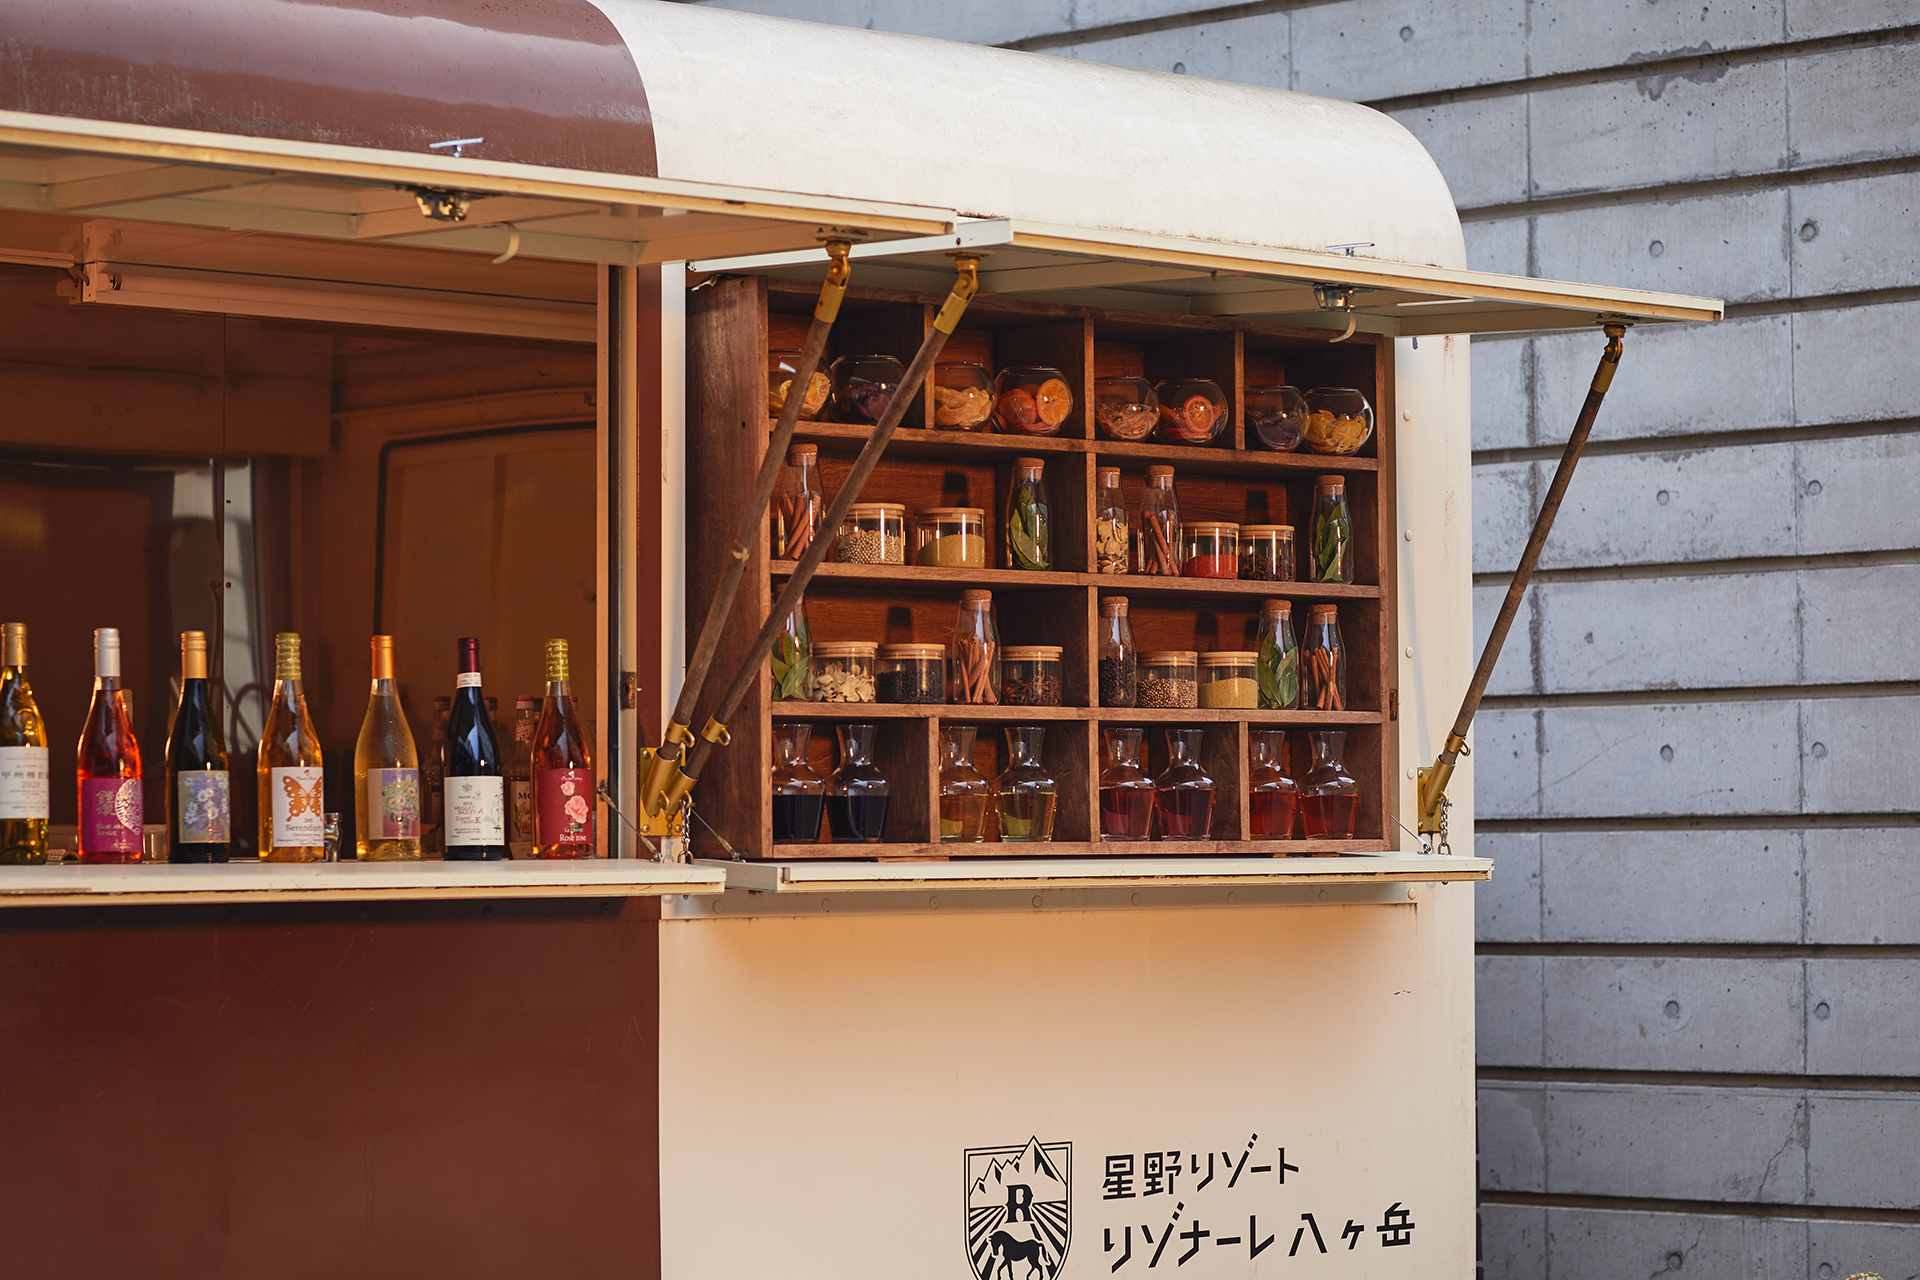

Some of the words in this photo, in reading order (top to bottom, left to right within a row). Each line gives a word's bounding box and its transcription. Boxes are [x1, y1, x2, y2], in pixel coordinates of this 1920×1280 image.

[1102, 1133, 1299, 1200] 星野リゾート
[1005, 1184, 1034, 1224] R
